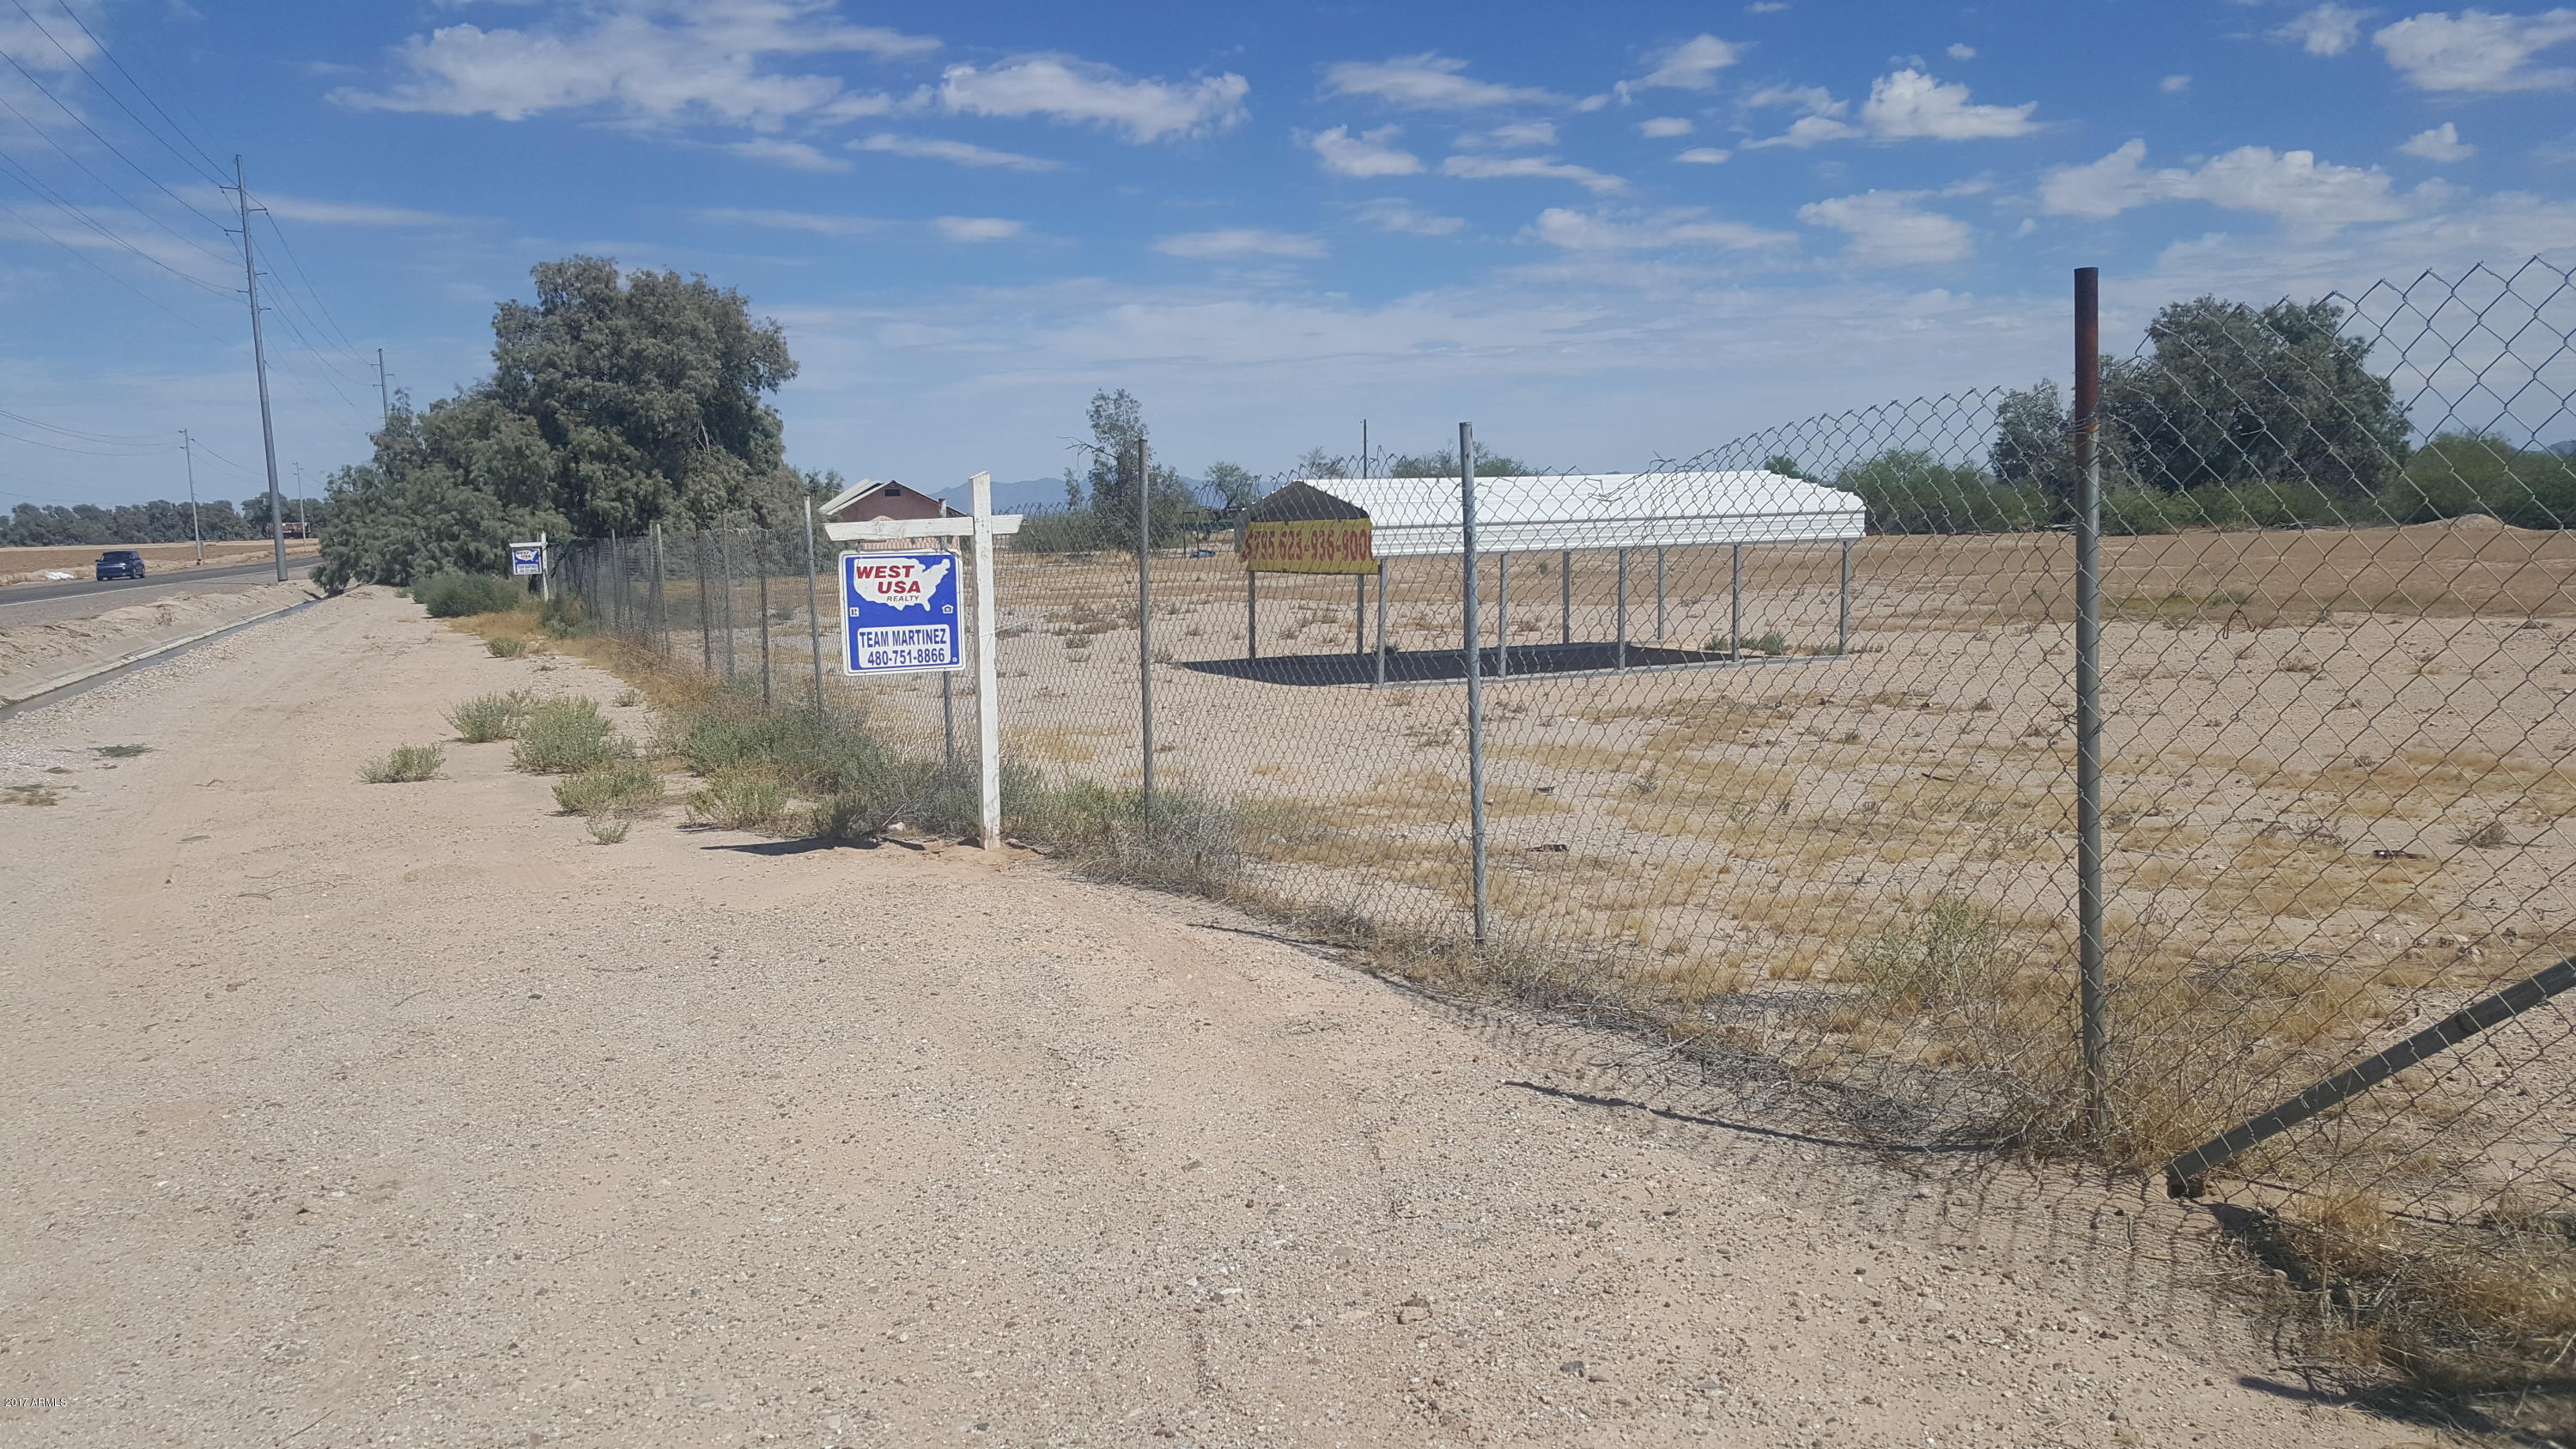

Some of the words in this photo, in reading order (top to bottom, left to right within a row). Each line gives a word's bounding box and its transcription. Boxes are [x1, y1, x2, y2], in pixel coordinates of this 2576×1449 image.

[856, 565, 915, 579] WEST
[877, 581, 921, 594] USA
[860, 630, 890, 648] TEAM
[892, 628, 947, 647] MARTINEZ
[867, 648, 945, 666] 480-751-8866
